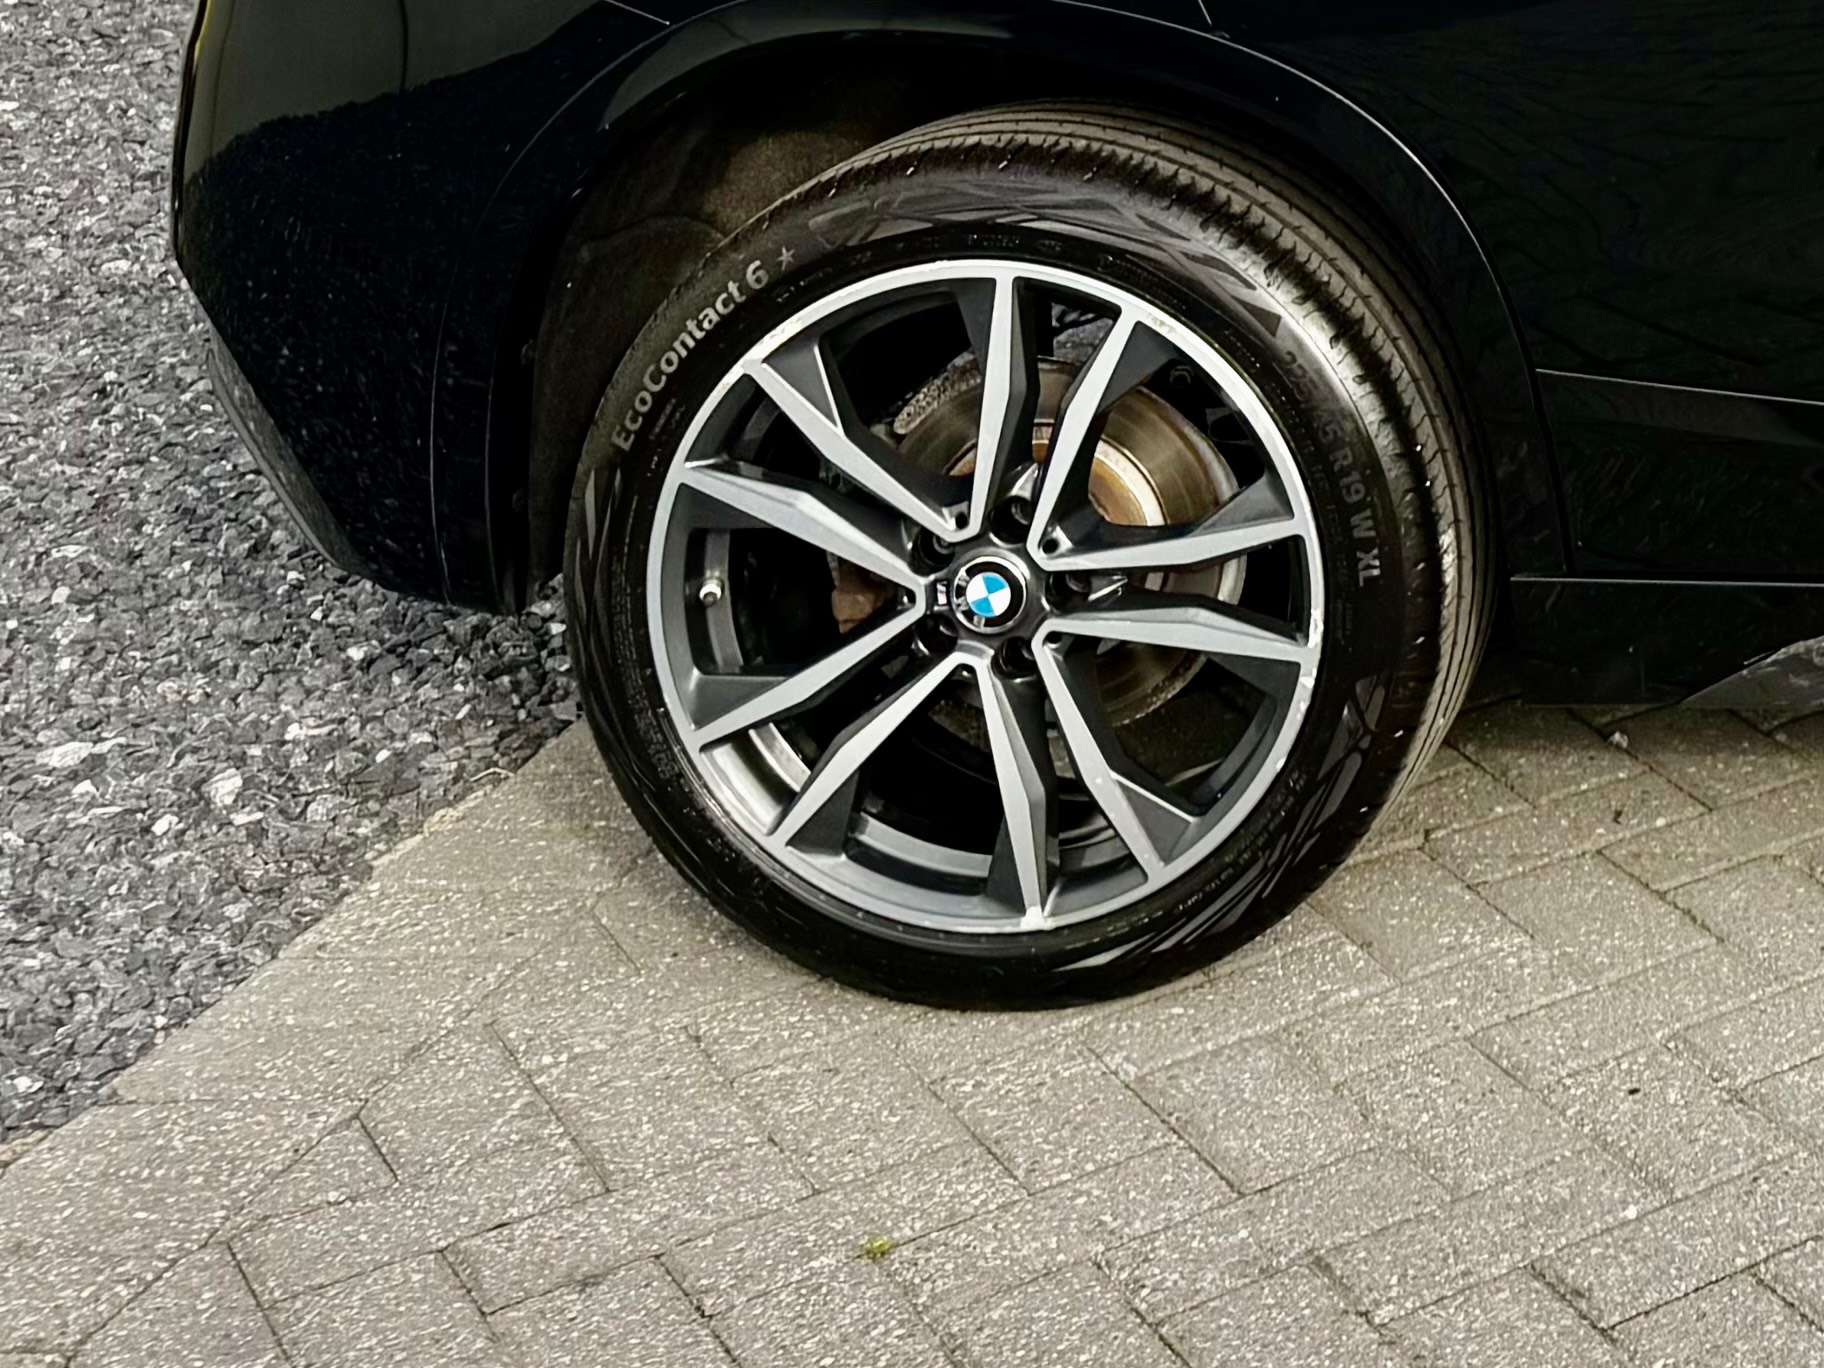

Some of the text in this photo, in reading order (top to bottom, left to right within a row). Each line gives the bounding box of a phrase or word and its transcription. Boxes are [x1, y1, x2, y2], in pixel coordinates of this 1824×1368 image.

[611, 260, 769, 451] EcoContact 6
[1356, 546, 1382, 587] XL
